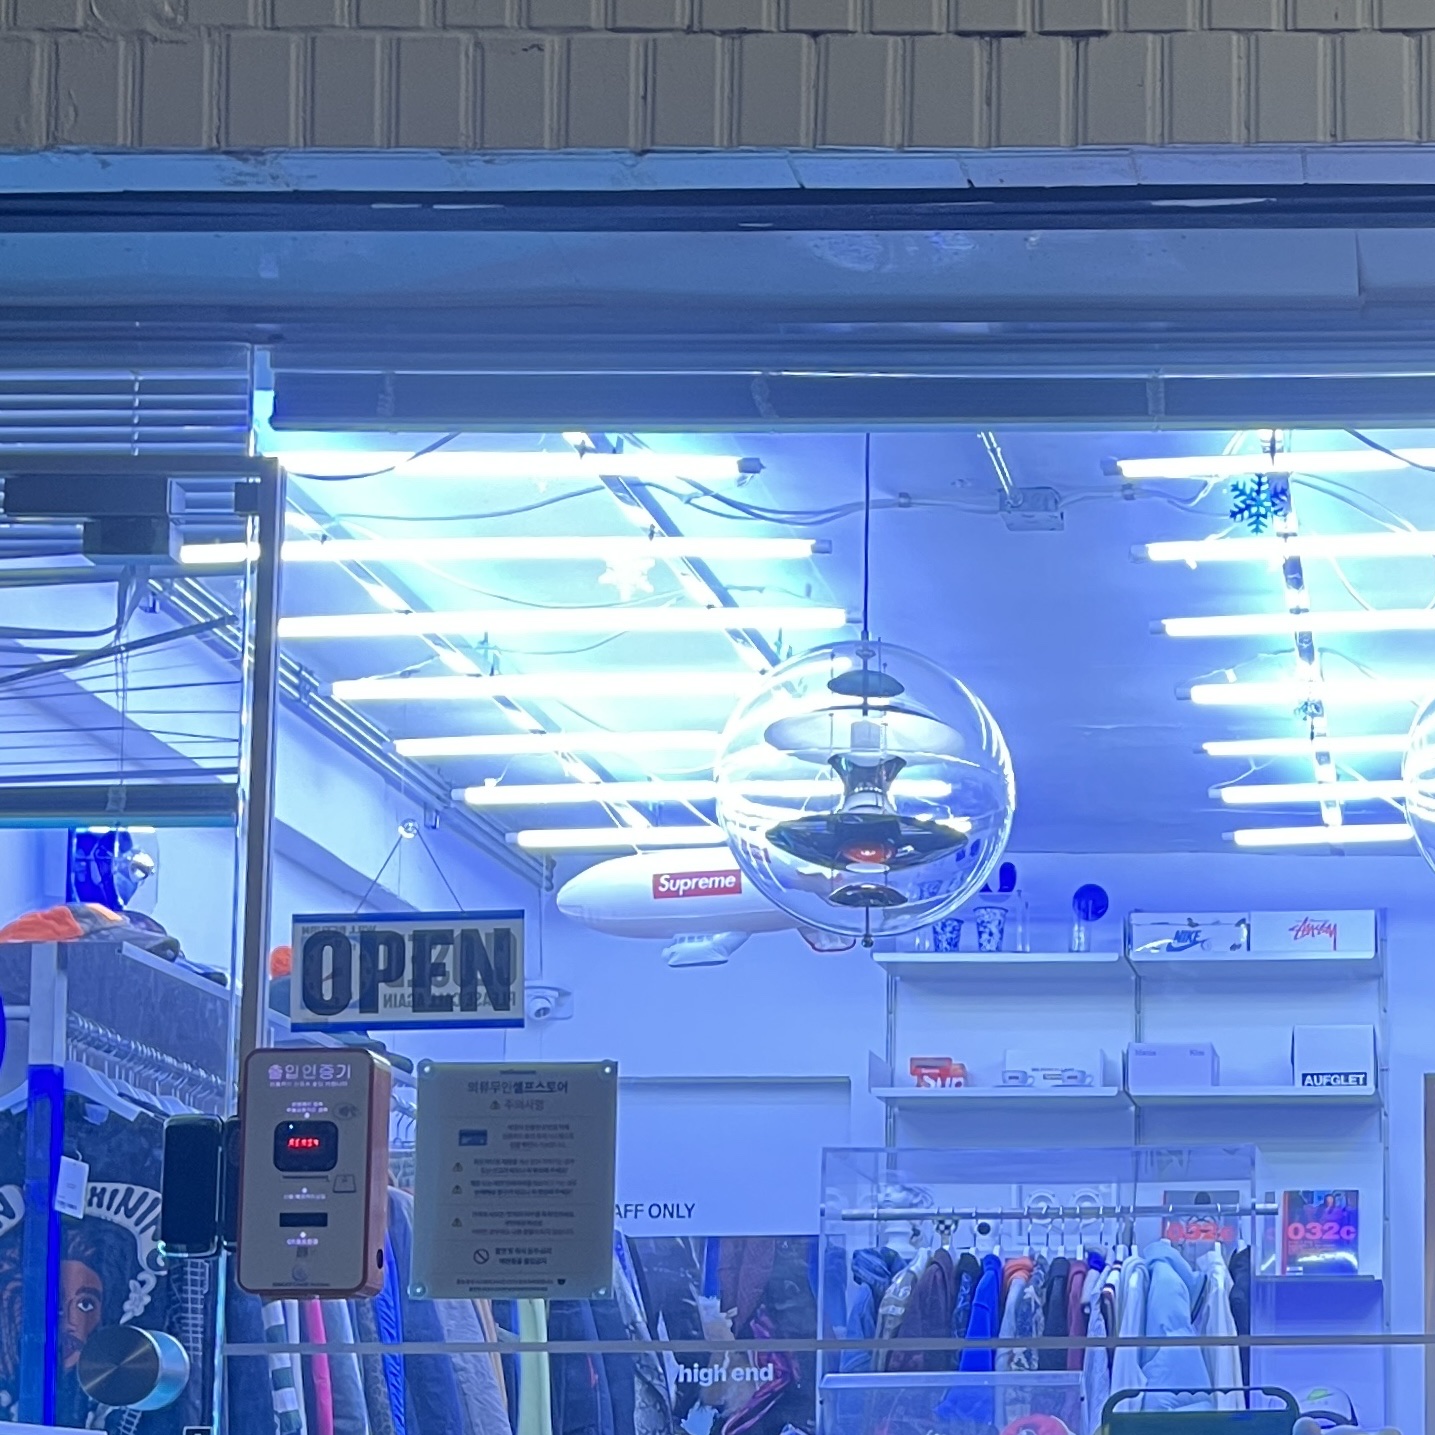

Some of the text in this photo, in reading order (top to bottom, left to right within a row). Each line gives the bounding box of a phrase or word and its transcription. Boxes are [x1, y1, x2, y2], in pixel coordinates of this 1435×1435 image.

[658, 874, 736, 896] Supreme
[1173, 929, 1202, 942] NIKE
[303, 928, 511, 1016] OPEN
[268, 1064, 351, 1080] 출입인증기
[1304, 1074, 1366, 1087] AUFGLET
[648, 1203, 695, 1219] ONLY
[1287, 1222, 1356, 1241] 032c
[678, 1363, 774, 1387] high end
